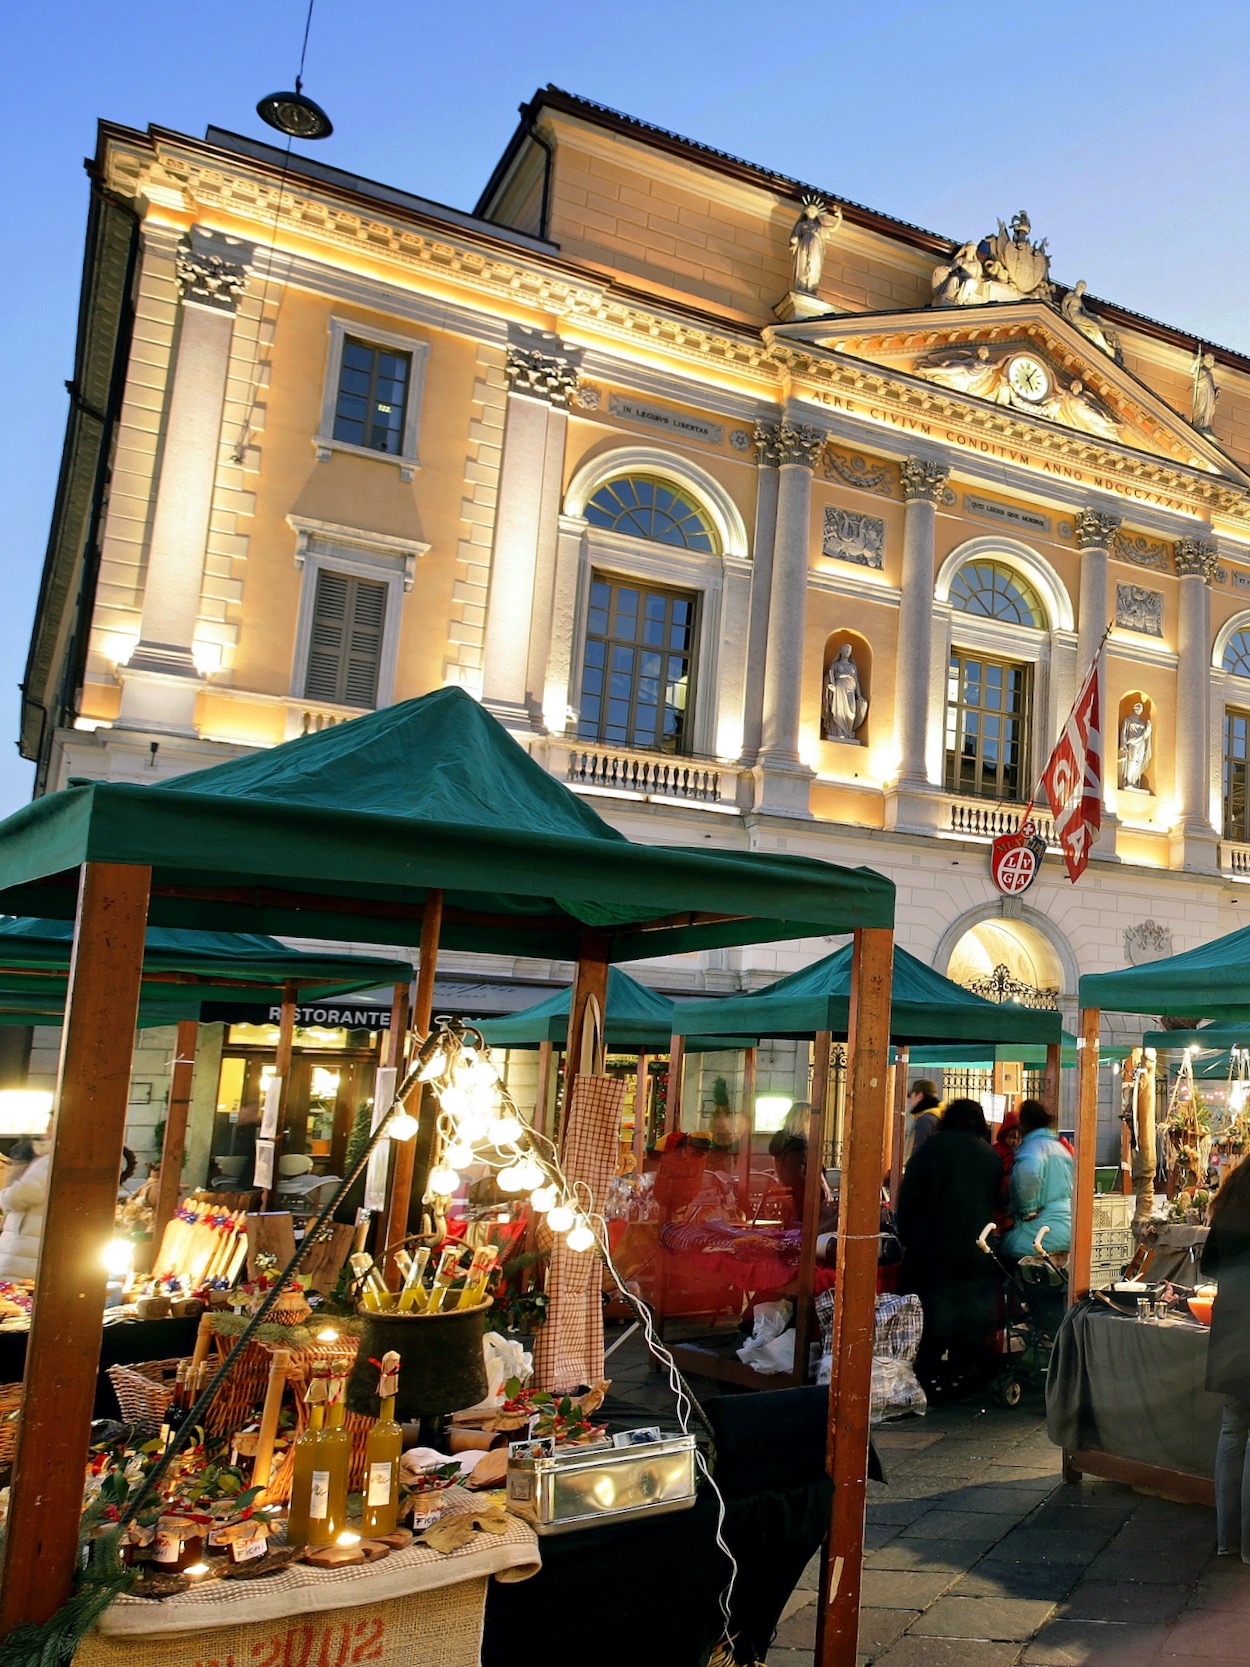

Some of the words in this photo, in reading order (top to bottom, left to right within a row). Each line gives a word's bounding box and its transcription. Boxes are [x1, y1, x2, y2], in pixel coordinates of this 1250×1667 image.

[622, 405, 631, 413] IN
[673, 420, 708, 435] LIBERTAS
[812, 391, 854, 412] AERE
[870, 408, 931, 435] CIVIVM
[945, 432, 1029, 466] CONDITVM
[1043, 462, 1082, 481] ANNO
[1094, 476, 1198, 516] MDCCCXXXXIV
[269, 1007, 391, 1026] RSTORANTE
